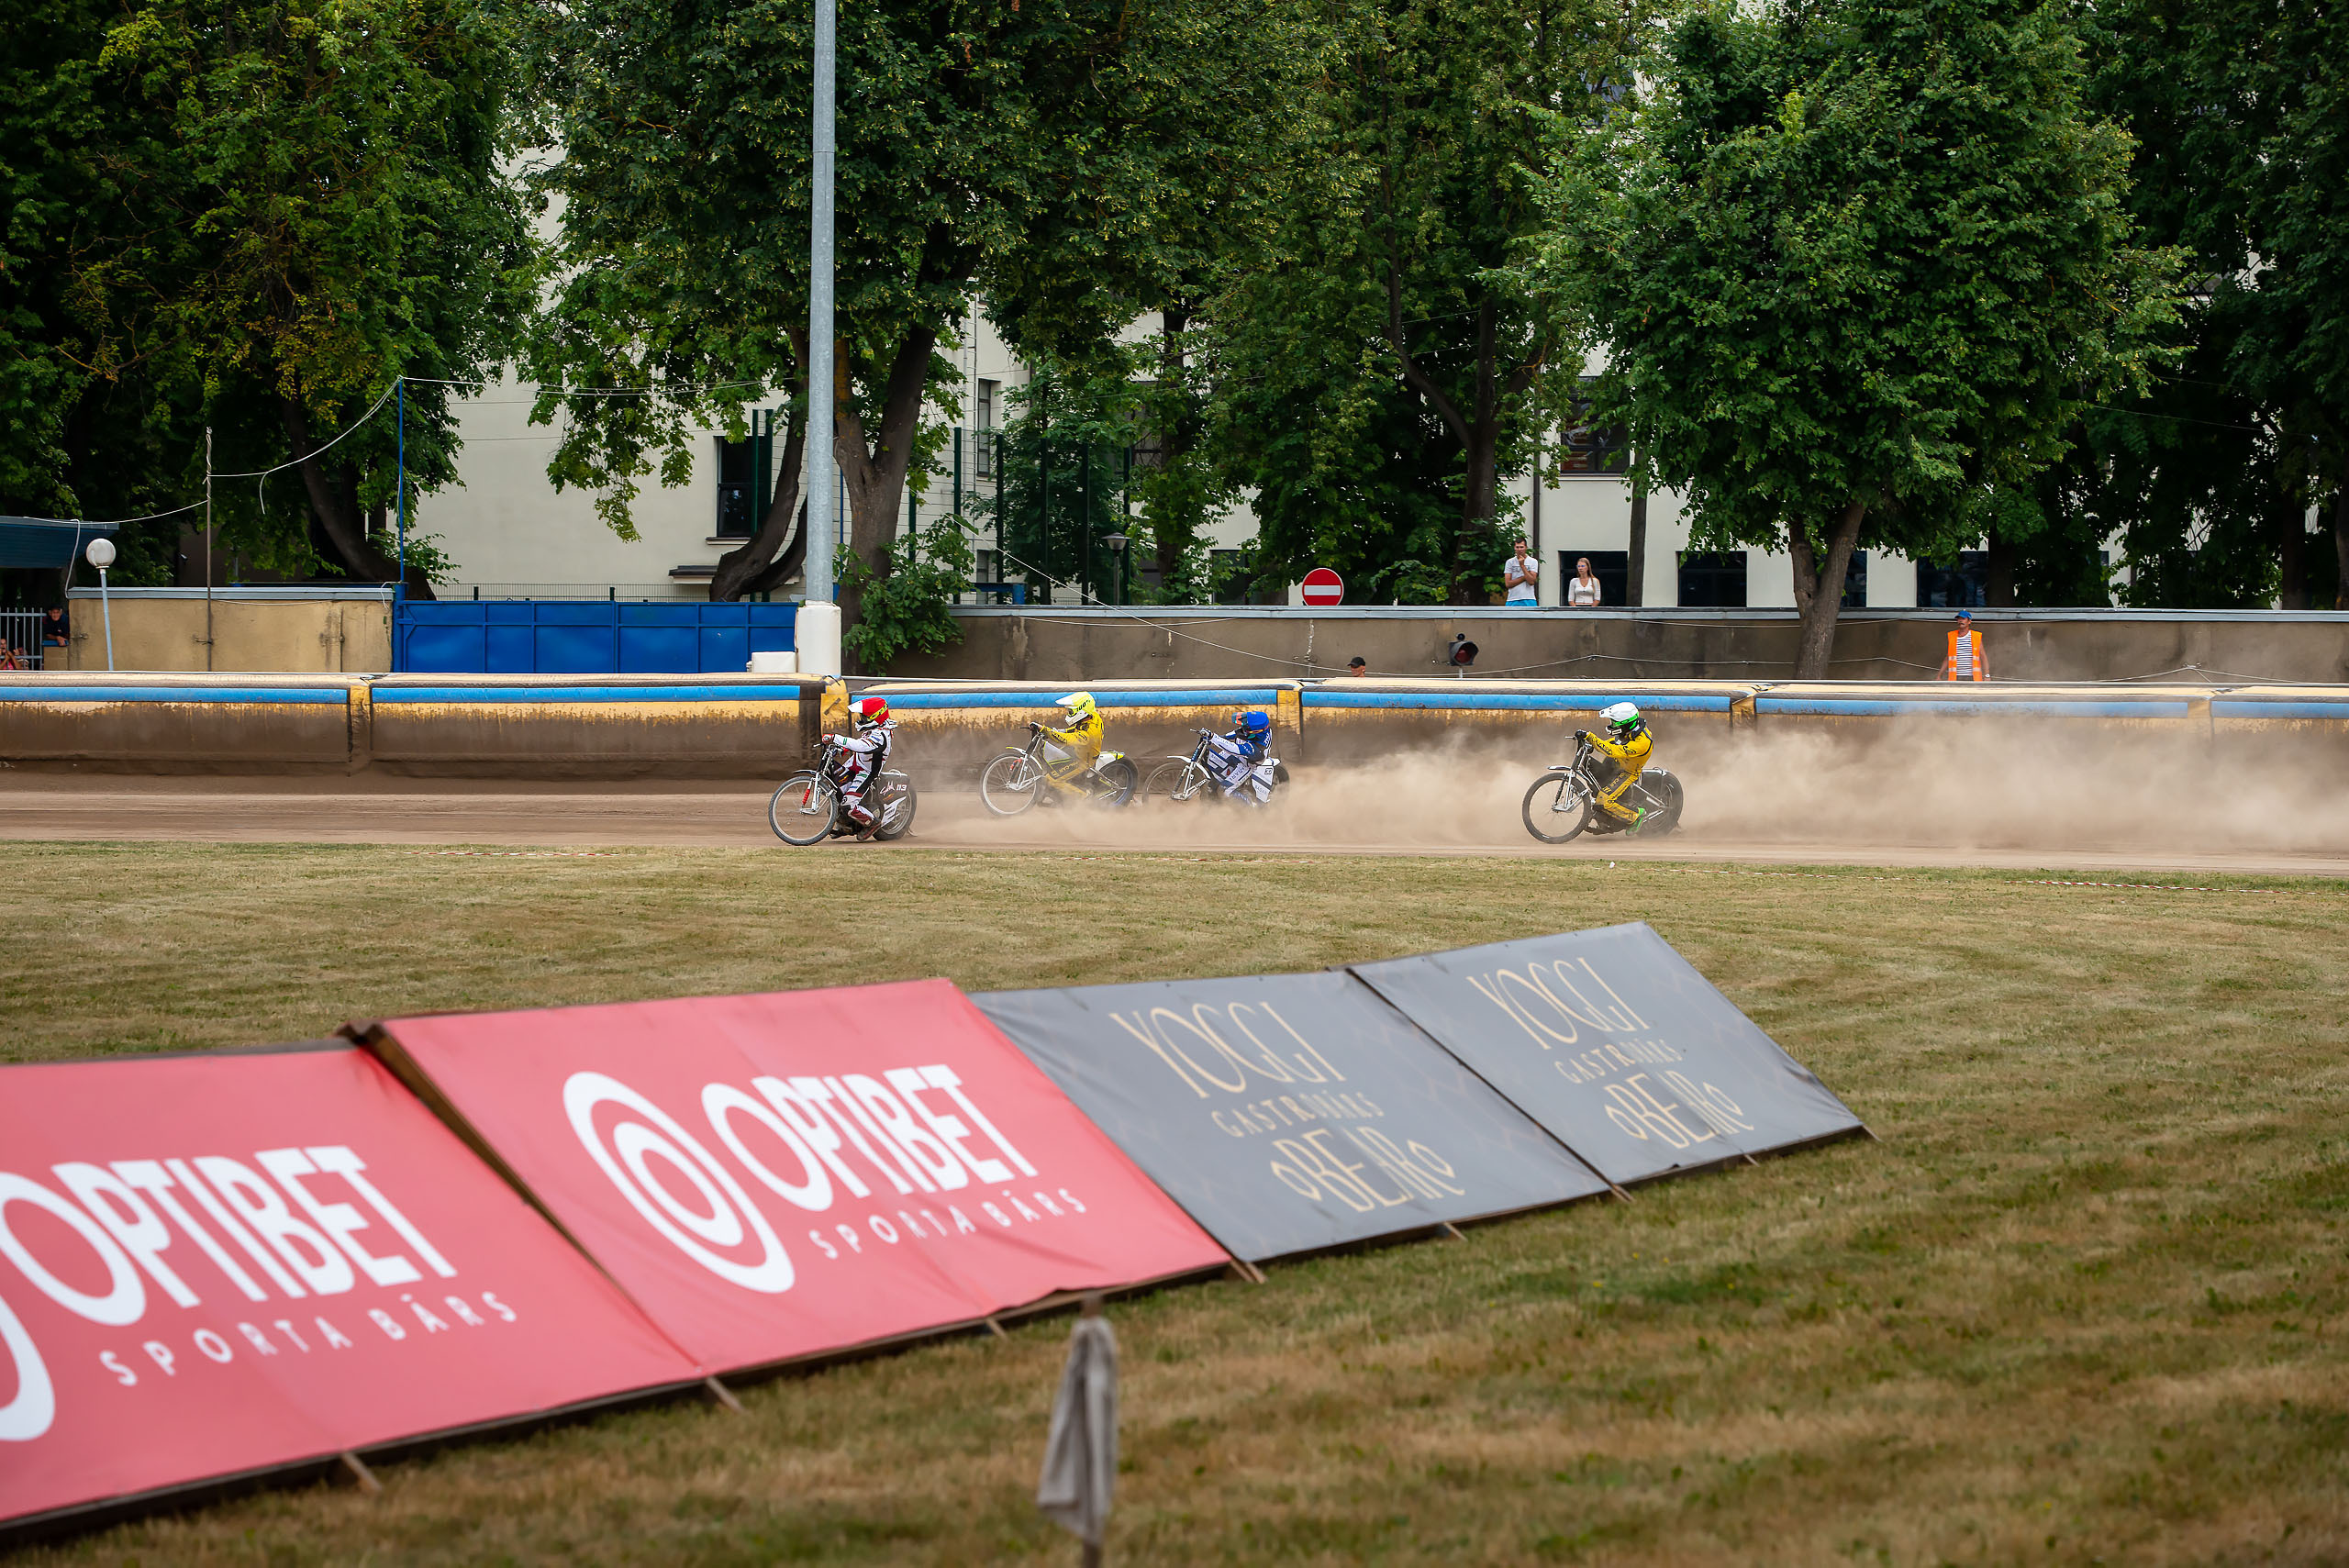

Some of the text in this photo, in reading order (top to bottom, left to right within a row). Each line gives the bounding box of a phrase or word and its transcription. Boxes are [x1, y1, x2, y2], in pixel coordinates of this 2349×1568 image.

[1108, 1001, 1346, 1098] YOGGI
[1466, 957, 1650, 1050] YOGGI
[700, 1064, 1039, 1211] OPTIBET
[0, 1145, 458, 1327] OPTIBET
[808, 1188, 1086, 1260] SPORTA BĀRS
[99, 1291, 518, 1386] SPORTA BĀRS
